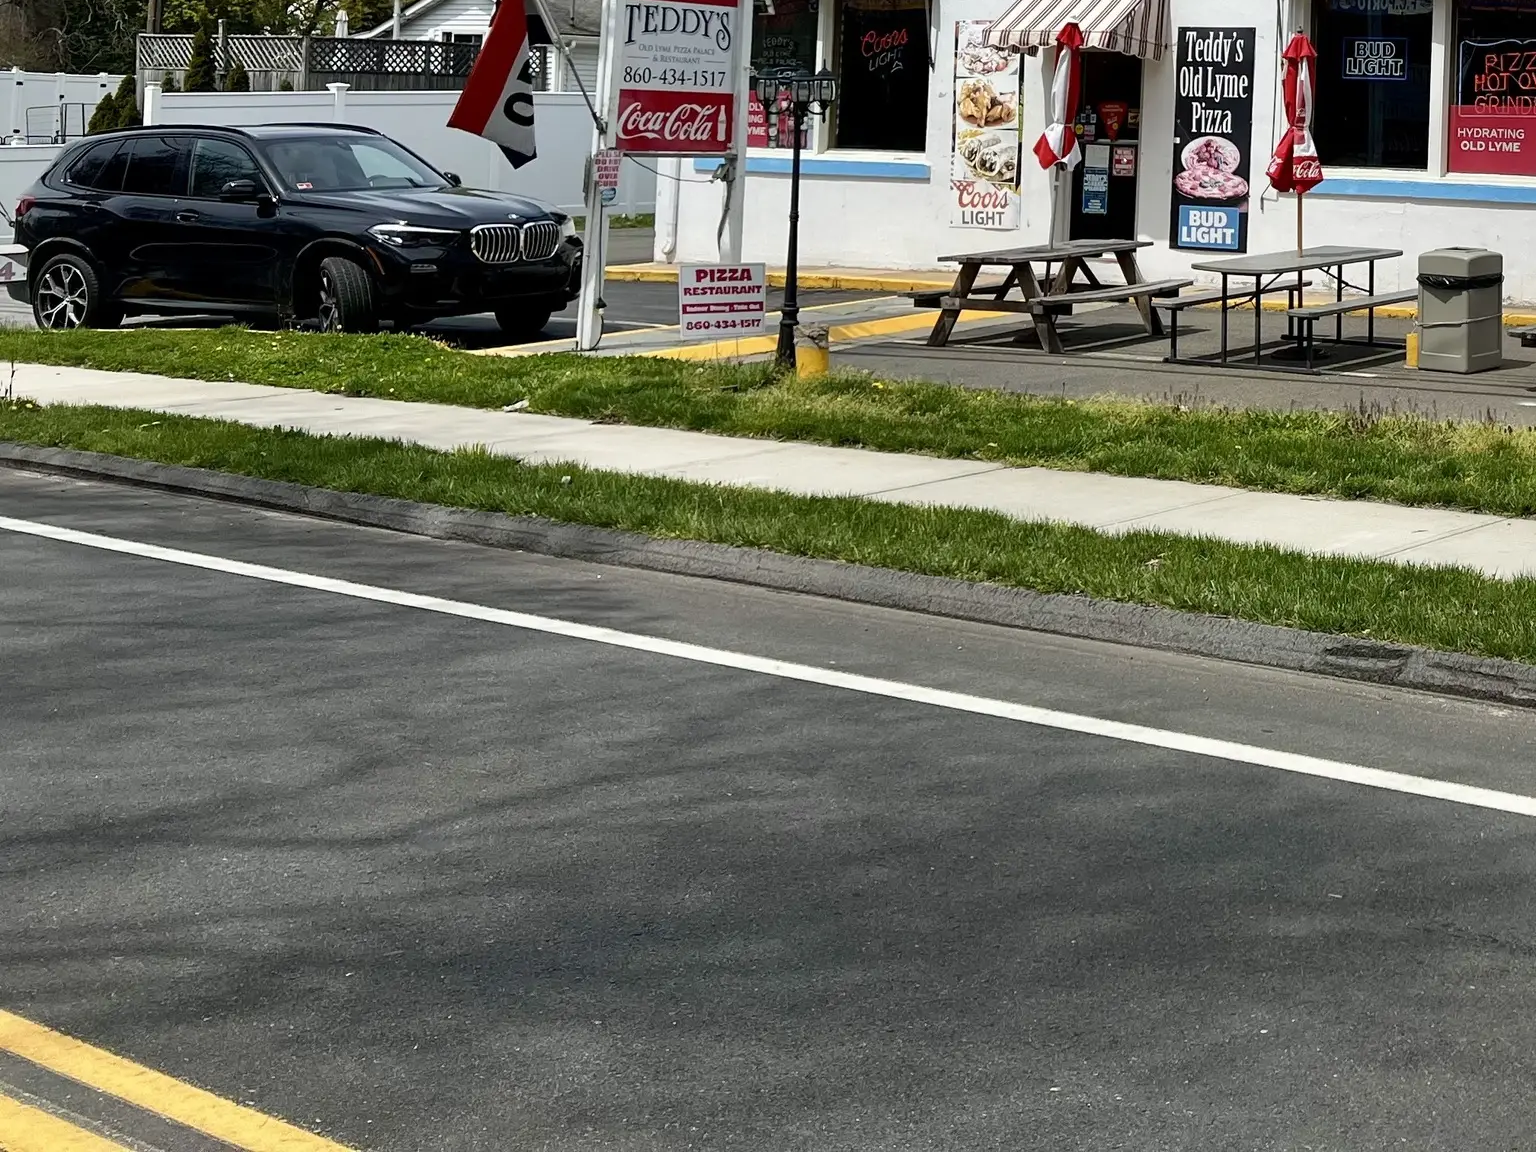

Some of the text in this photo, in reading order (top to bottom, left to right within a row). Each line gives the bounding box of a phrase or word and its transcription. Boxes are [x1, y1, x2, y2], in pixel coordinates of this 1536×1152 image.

[624, 3, 731, 52] TEDDY'S
[638, 43, 654, 53] OLD
[673, 44, 692, 55] PIZZA
[861, 28, 908, 57] Coors
[1185, 31, 1245, 67] Teddy's
[1354, 41, 1396, 58] BUD
[660, 54, 701, 65] RESTAURANT
[868, 47, 904, 72] LIGHT
[1346, 57, 1403, 76] LIGHT
[623, 65, 726, 88] 860-434-1517
[1180, 66, 1249, 103] Old Lyme
[1474, 73, 1510, 93] HOT
[616, 102, 718, 141] Coca-Cola
[1191, 101, 1233, 134] Pizza
[747, 126, 767, 136] YME
[1457, 127, 1526, 140] HYDRATING
[1460, 140, 1521, 153] OLD LYME
[957, 180, 1009, 209] Coors
[961, 210, 1005, 226] LIGHT
[1188, 210, 1228, 228] BUD
[1181, 225, 1235, 245] LIGHT
[695, 268, 753, 283] PIZZA
[683, 285, 763, 296] RESTAURANT
[685, 318, 762, 331] 860-434-1517
